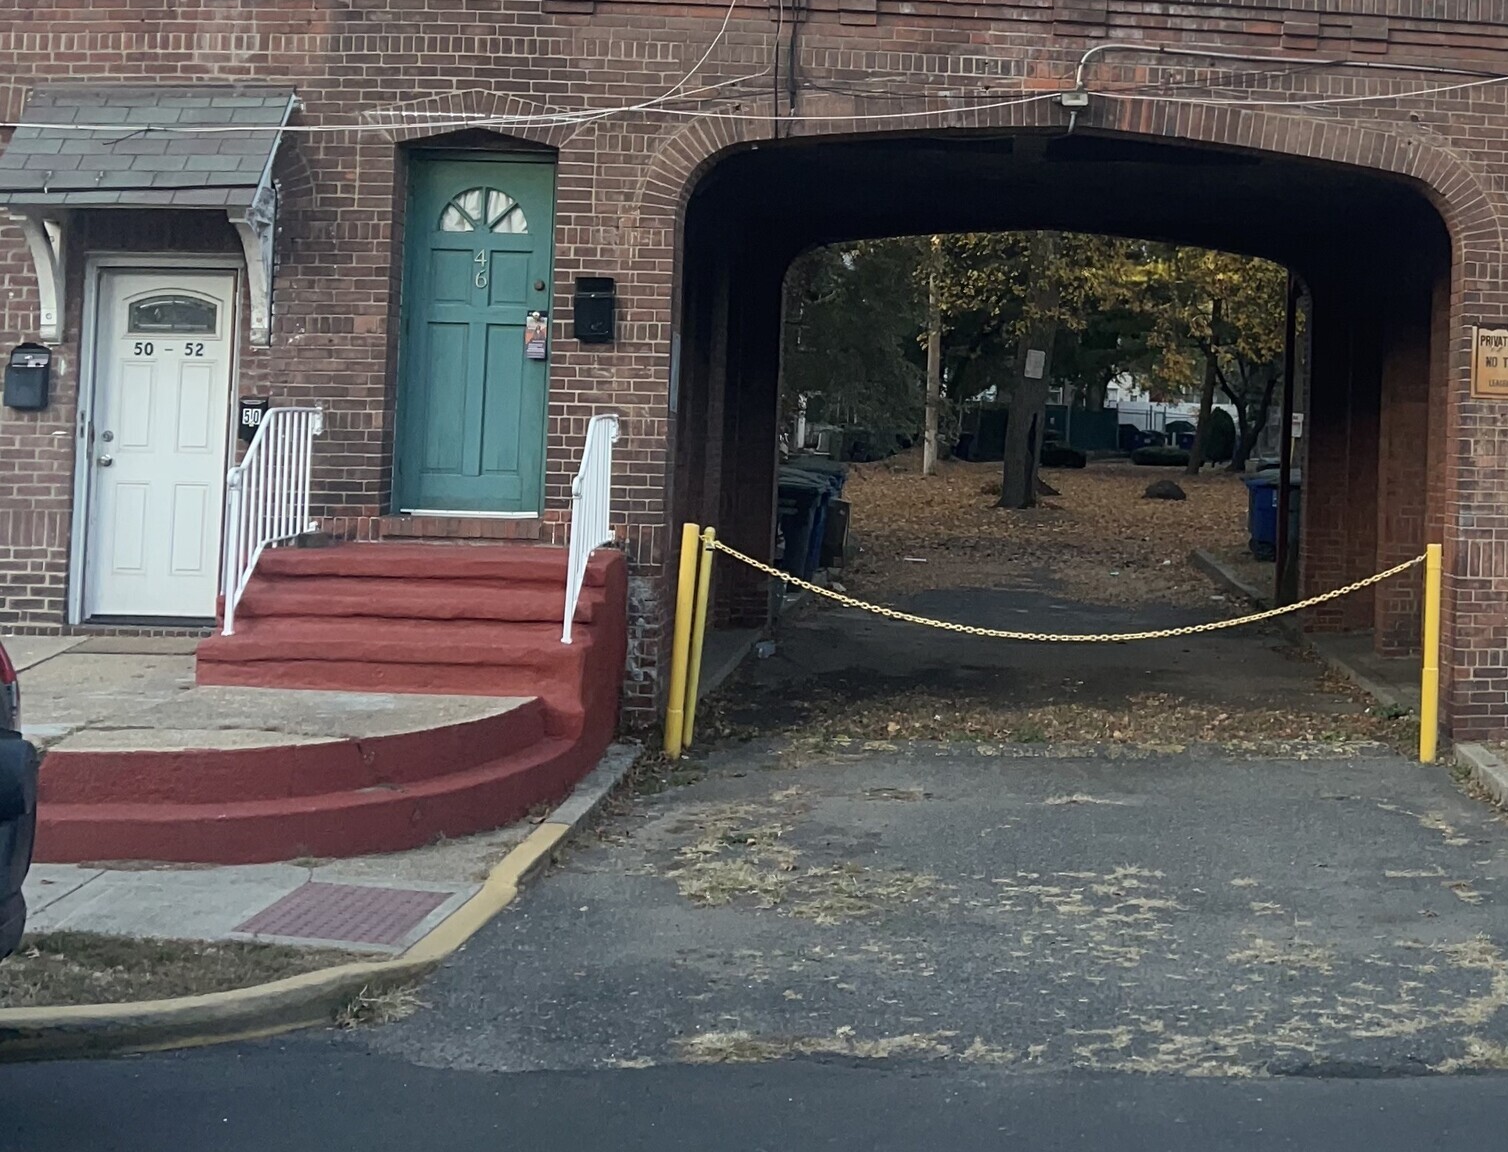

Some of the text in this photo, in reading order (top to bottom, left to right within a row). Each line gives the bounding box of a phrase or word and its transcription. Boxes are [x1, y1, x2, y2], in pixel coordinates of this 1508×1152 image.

[133, 342, 154, 356] 50
[184, 342, 204, 357] 52
[1485, 356, 1498, 368] NO
[243, 409, 260, 424] 50
